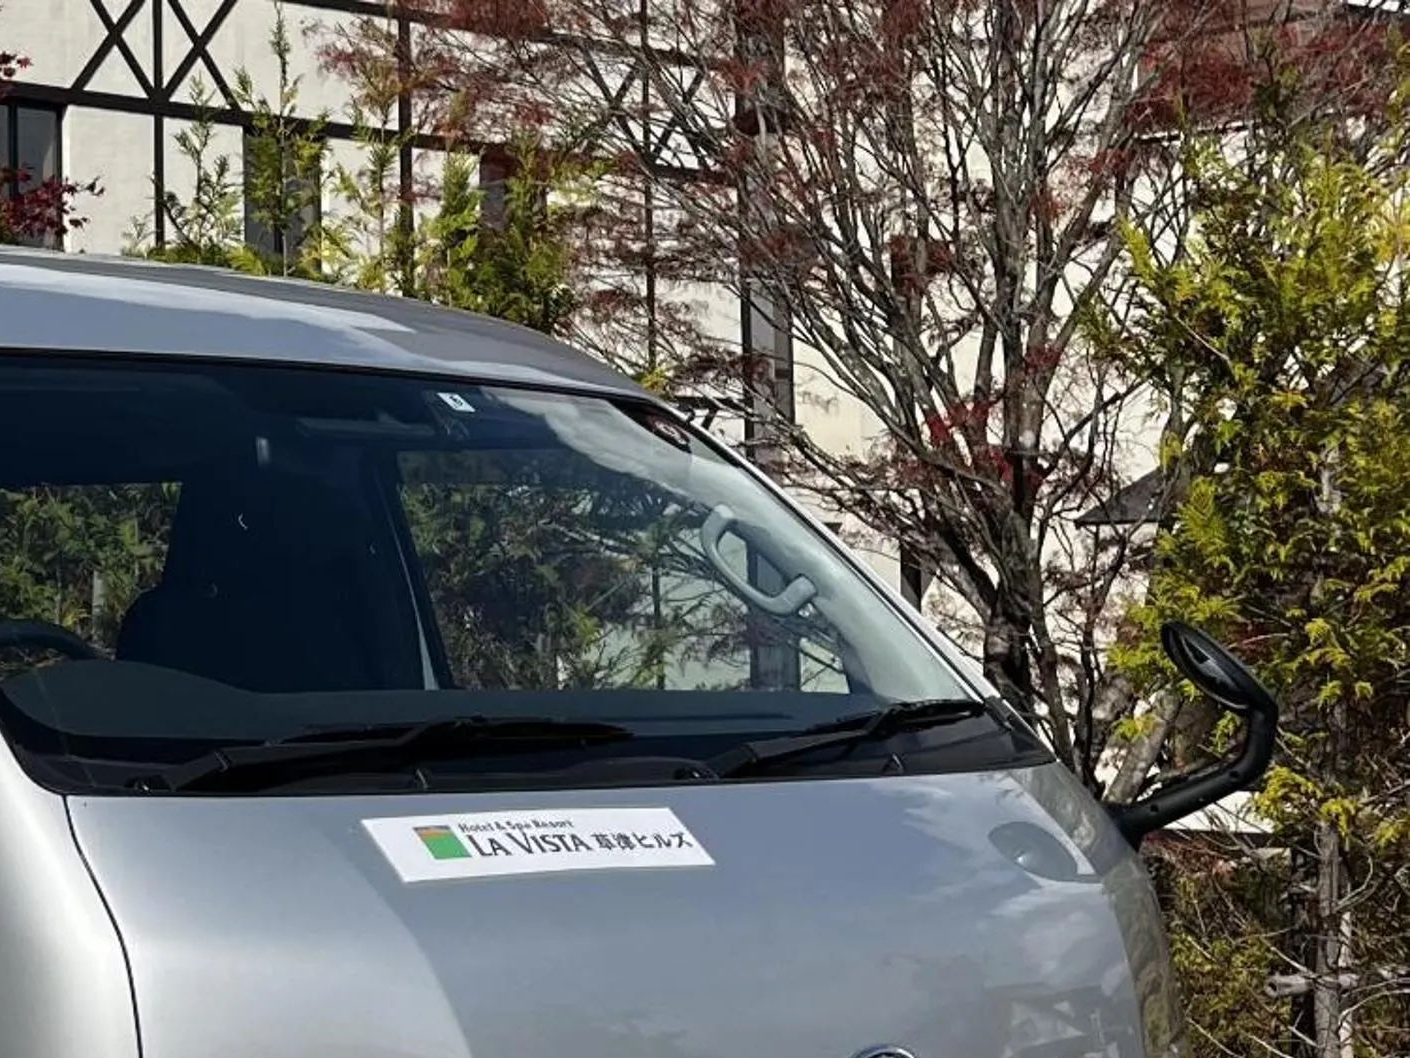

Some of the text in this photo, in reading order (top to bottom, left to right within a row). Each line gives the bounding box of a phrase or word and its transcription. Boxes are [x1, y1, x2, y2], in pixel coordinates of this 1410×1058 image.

[466, 831, 694, 856] LA VISTA 草津ヒルズ
